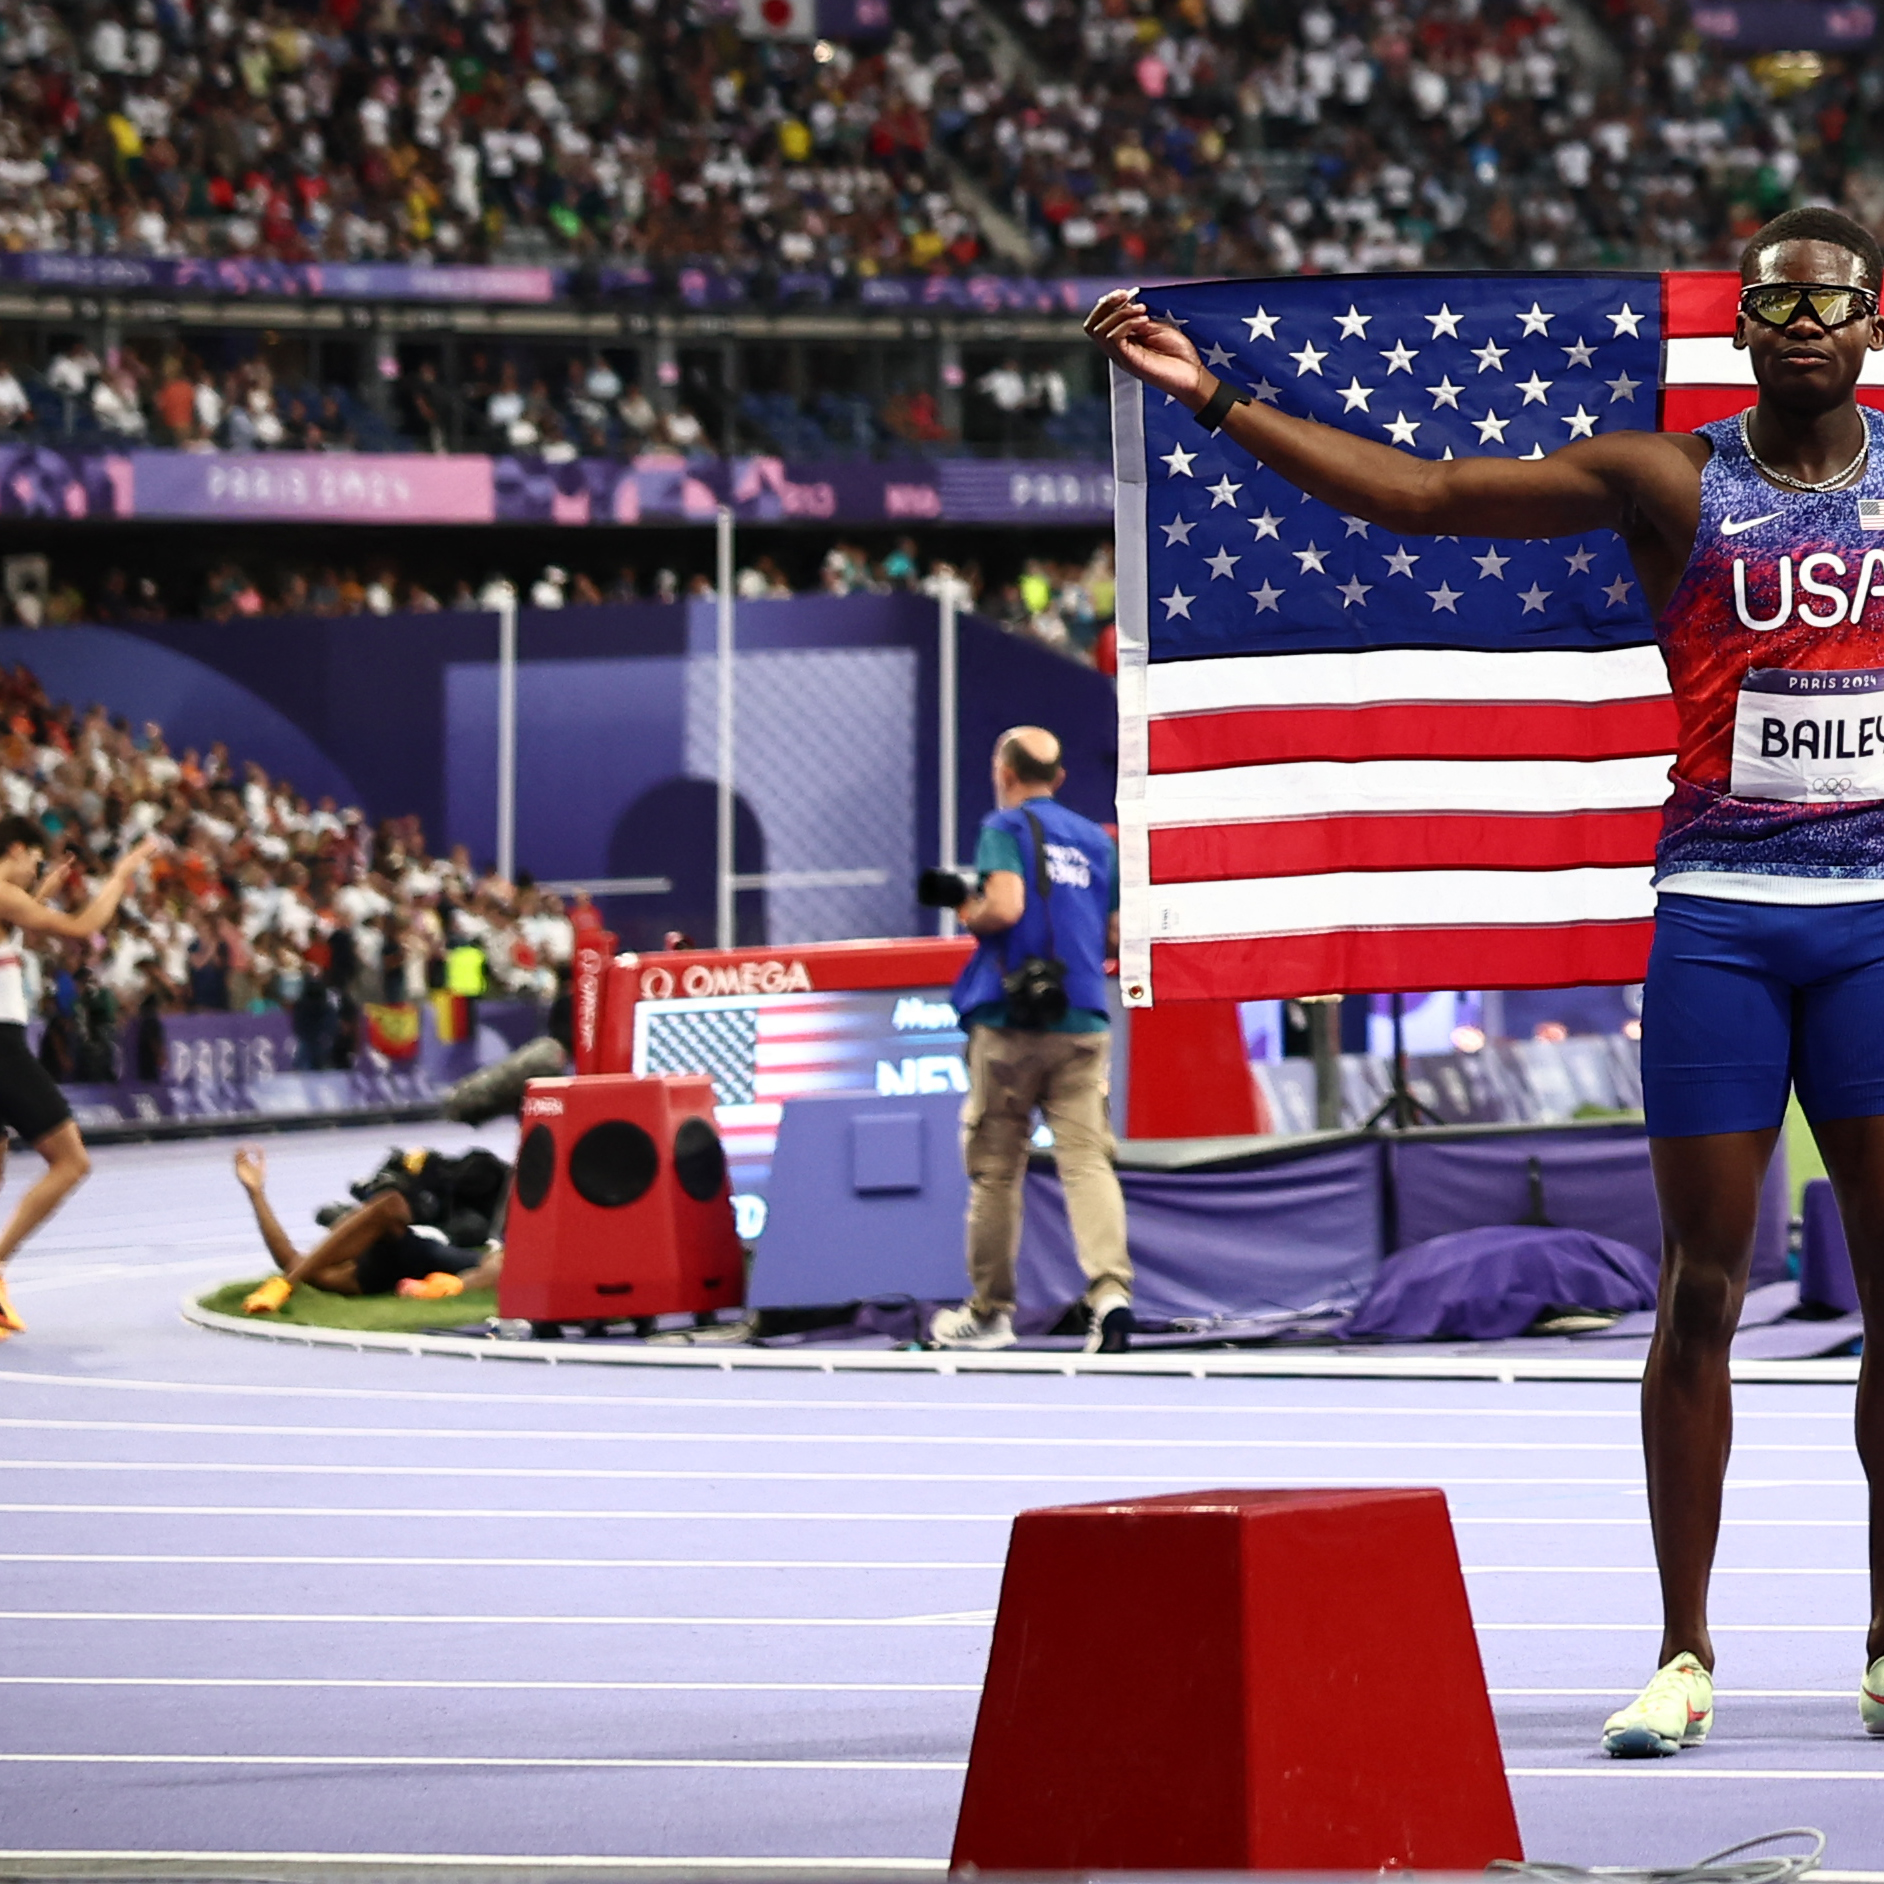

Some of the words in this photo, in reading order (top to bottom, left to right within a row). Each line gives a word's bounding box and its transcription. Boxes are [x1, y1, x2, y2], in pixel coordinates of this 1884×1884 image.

[1789, 676, 1836, 690] PARIS
[1842, 675, 1877, 690] 2024
[682, 961, 813, 998] OMEGA
